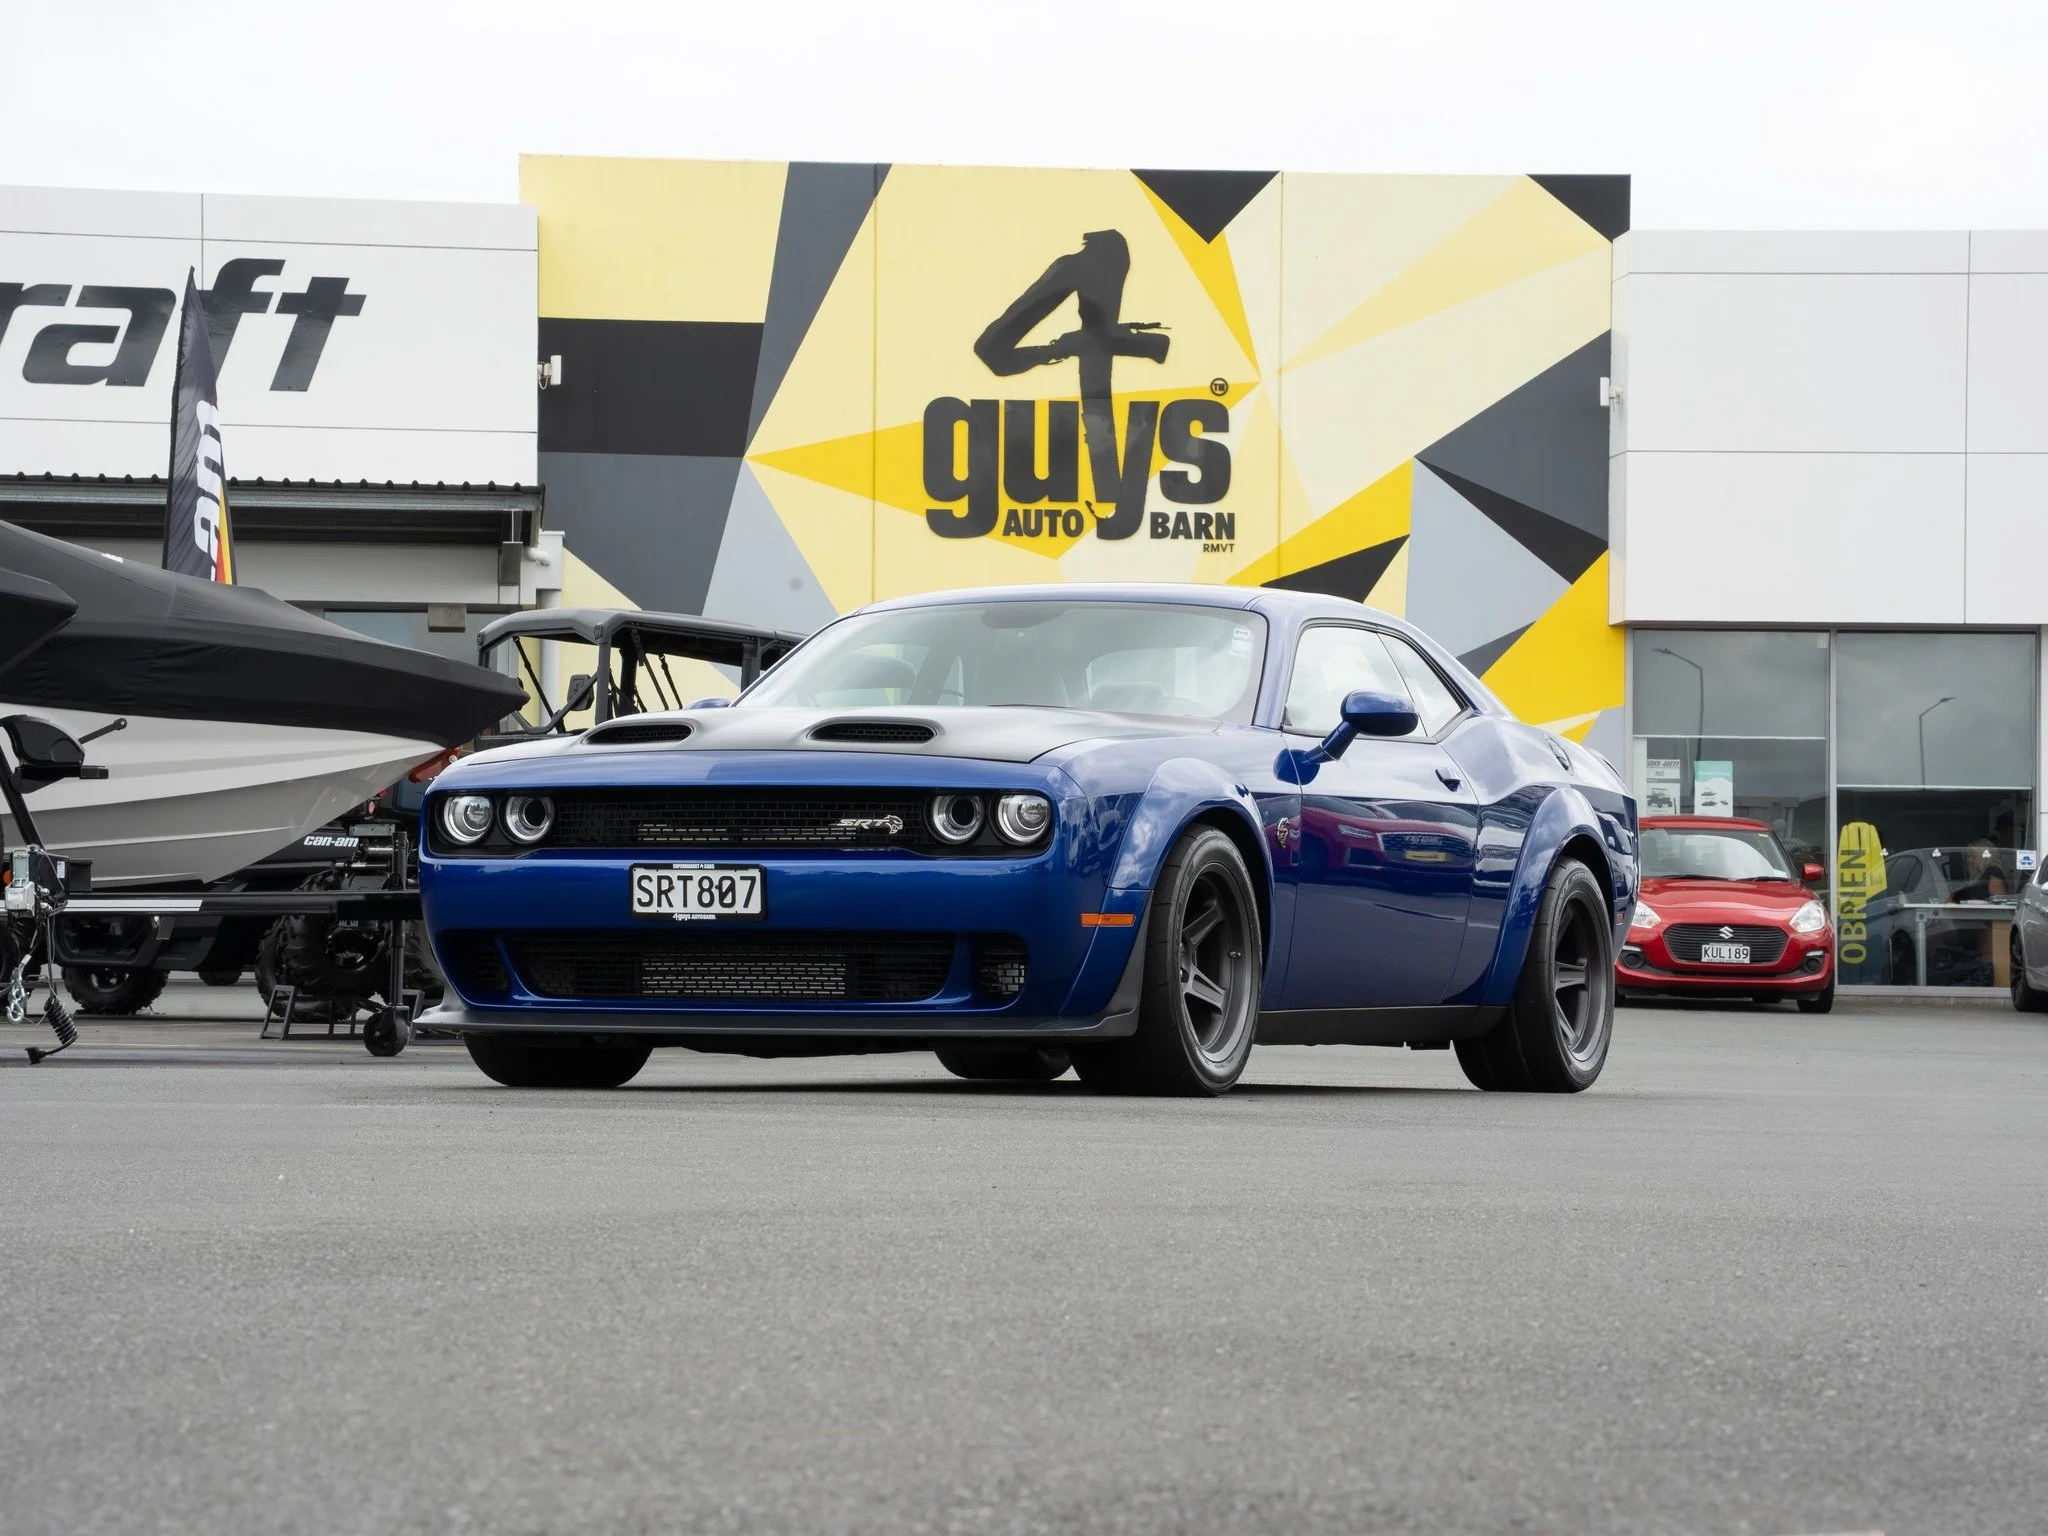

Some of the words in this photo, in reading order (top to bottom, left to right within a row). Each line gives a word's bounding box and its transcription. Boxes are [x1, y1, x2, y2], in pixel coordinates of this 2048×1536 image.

[974, 229, 1172, 470] 4
[923, 396, 1232, 540] guys
[1002, 508, 1084, 538] AUTO
[1149, 511, 1236, 540] BARN
[1203, 543, 1234, 553] RMVT
[836, 818, 889, 829] SRT
[304, 836, 359, 847] can-am
[637, 875, 757, 908] SRT807
[1703, 946, 1749, 959] KUL189
